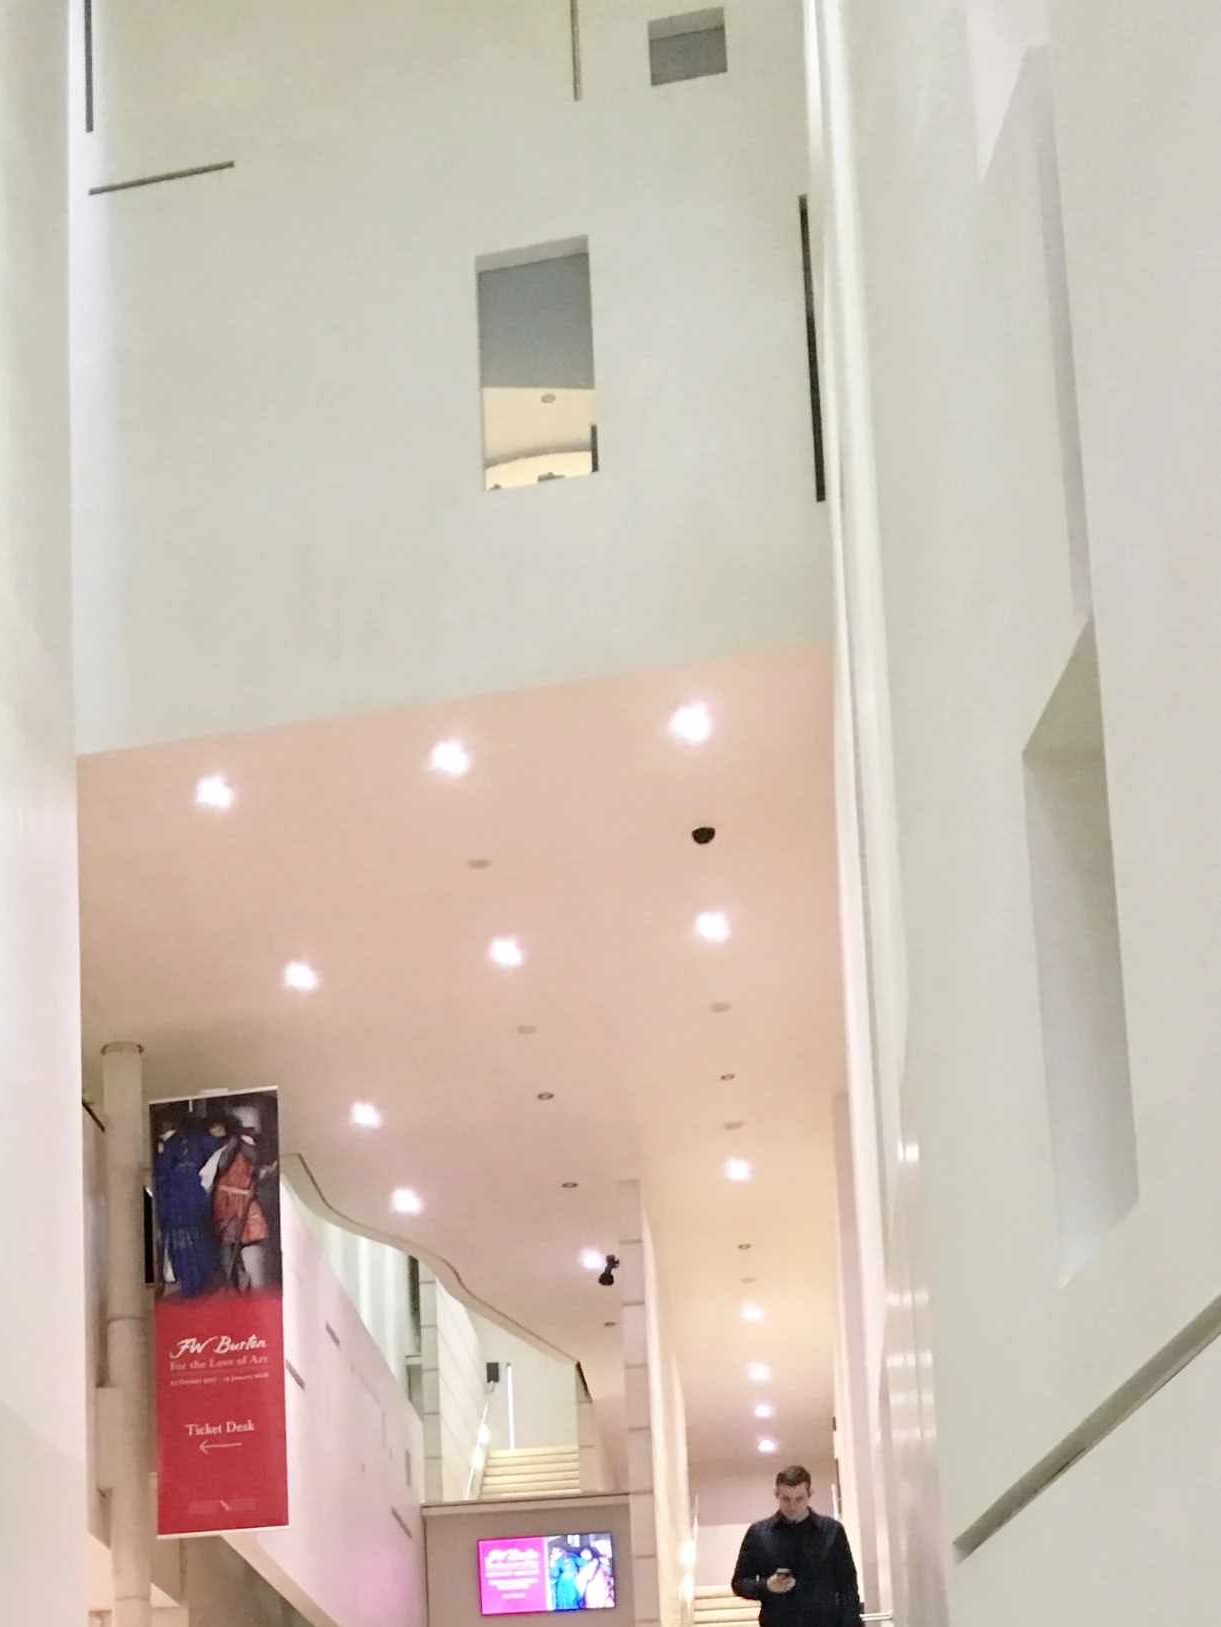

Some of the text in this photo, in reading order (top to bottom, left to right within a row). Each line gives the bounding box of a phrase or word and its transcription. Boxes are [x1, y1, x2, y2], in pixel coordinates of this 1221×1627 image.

[212, 1334, 267, 1354] Burton
[170, 1355, 268, 1371] For the Love of Art
[184, 1419, 255, 1436] Ticket Desk
